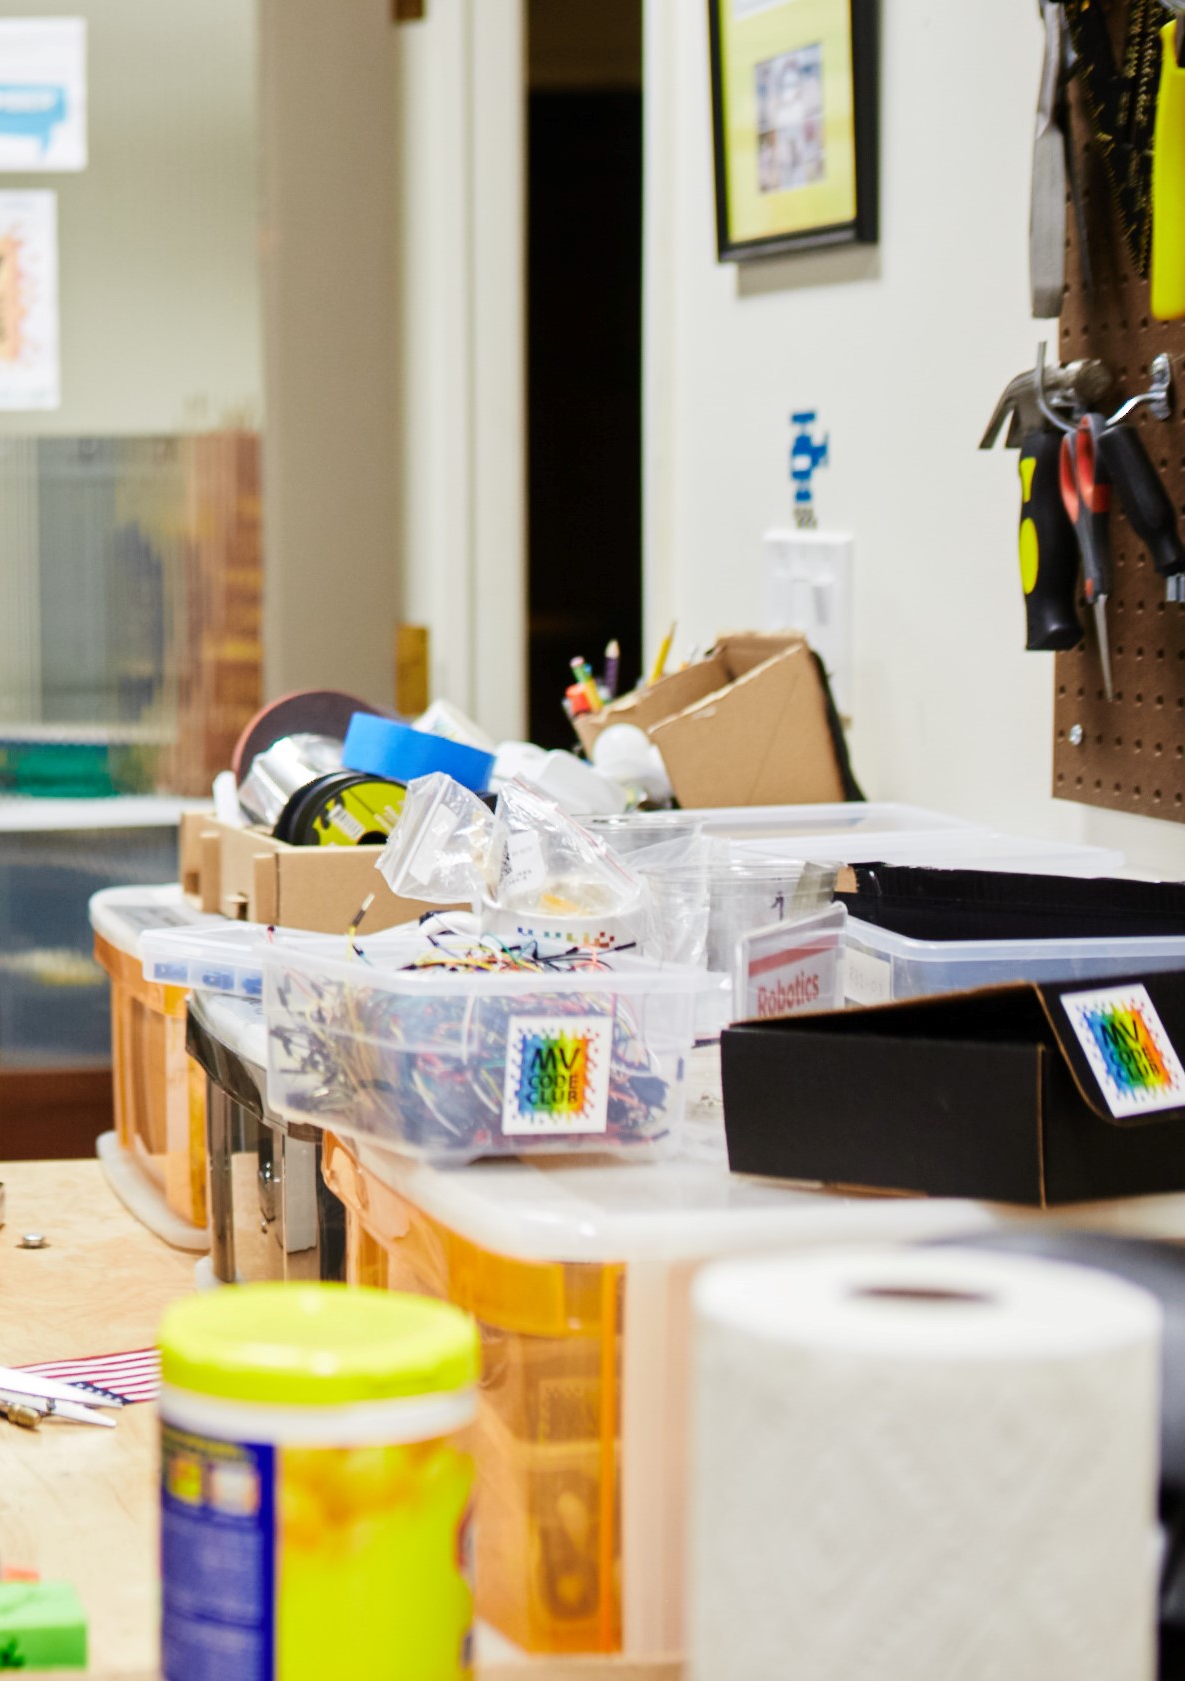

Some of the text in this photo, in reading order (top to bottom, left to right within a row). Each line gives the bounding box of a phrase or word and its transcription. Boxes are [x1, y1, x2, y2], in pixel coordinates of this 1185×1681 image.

[757, 971, 820, 1018] Robotics
[1100, 1019, 1140, 1049] MV
[530, 1047, 580, 1070] MV
[528, 1075, 579, 1090] CODE
[526, 1090, 578, 1106] CLUB
